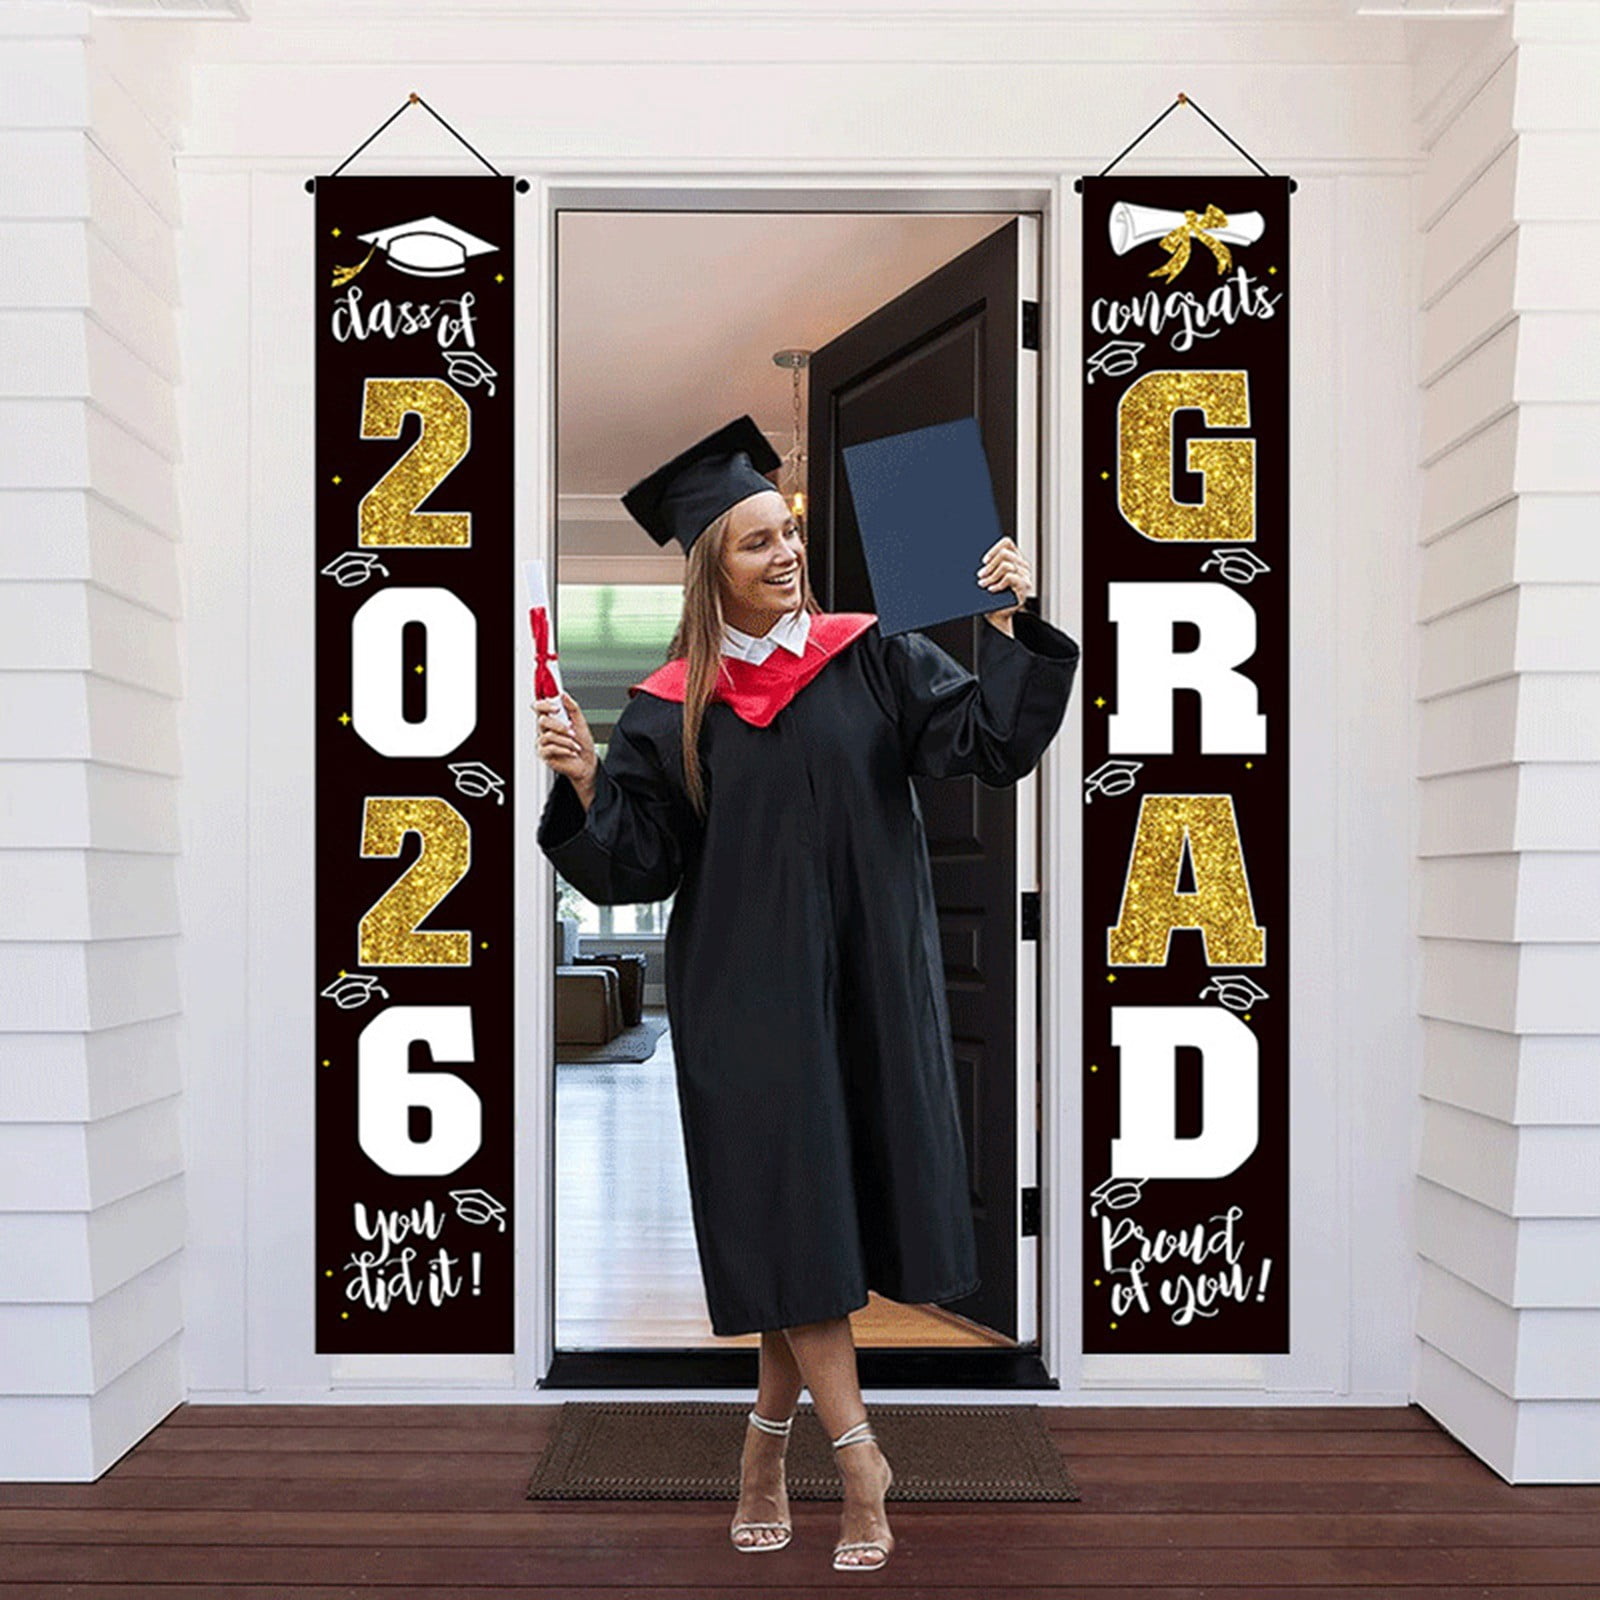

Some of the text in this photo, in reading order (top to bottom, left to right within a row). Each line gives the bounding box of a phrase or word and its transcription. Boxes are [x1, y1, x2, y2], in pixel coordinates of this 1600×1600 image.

[332, 286, 478, 348] class of
[1091, 265, 1284, 352] congrats
[350, 376, 483, 1177] 2026
[1107, 369, 1268, 1181] GRAD
[1101, 1205, 1246, 1272] Proud
[343, 1247, 424, 1312] did
[1110, 1257, 1273, 1326] of you!
